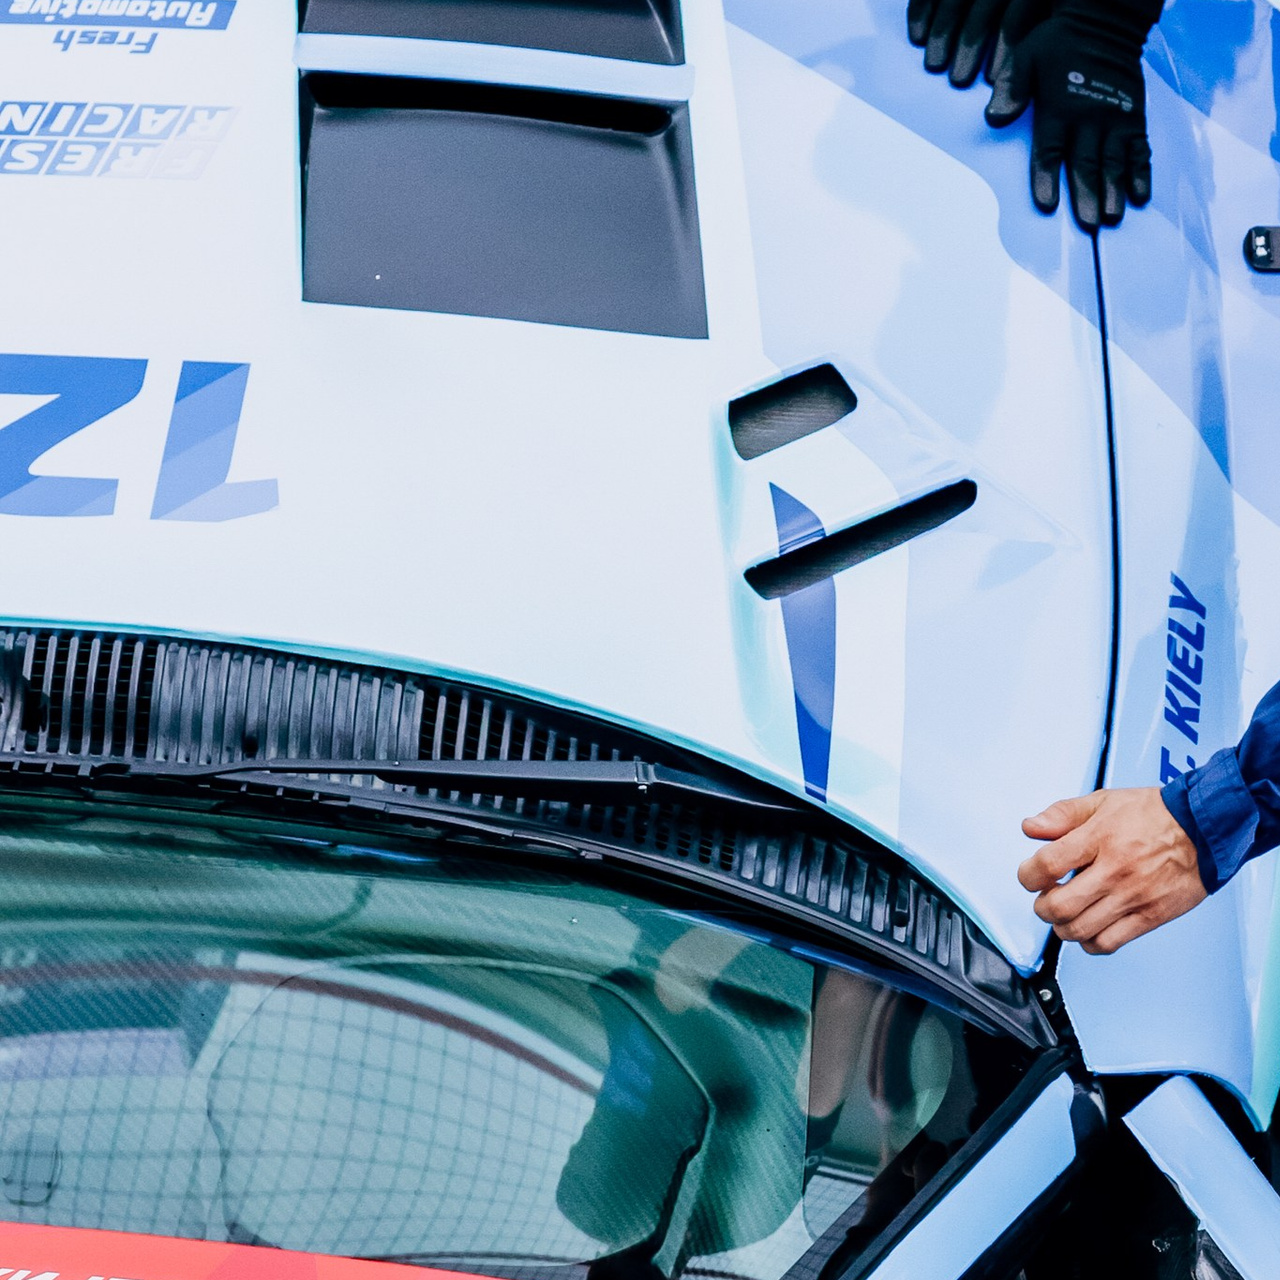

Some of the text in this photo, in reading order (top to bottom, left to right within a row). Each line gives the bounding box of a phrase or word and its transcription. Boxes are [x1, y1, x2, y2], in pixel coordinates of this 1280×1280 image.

[53, 30, 159, 54] Fresh
[0, 353, 280, 523] 12
[1164, 570, 1207, 745] KIELY
